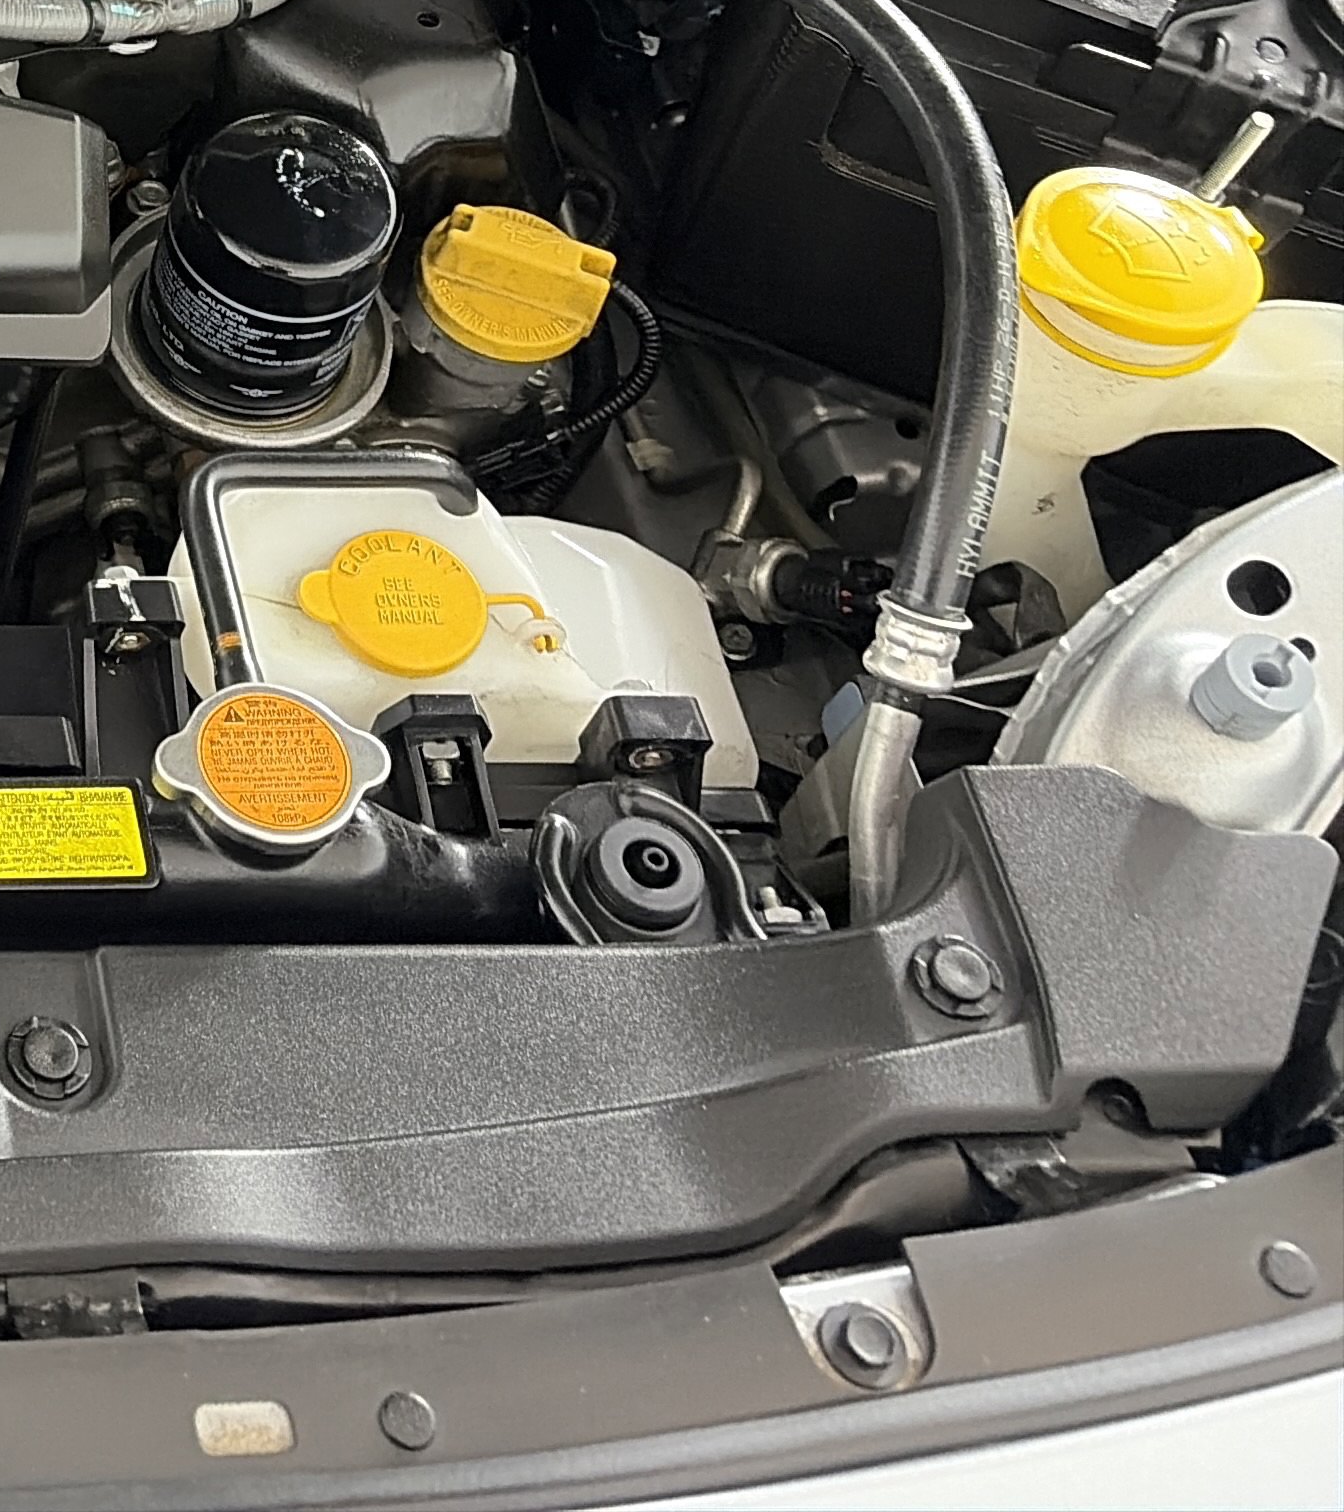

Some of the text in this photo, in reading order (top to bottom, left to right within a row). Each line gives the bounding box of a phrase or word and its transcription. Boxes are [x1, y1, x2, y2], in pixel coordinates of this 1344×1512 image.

[197, 290, 248, 325] CAUTION
[434, 278, 454, 301] SEE
[515, 319, 571, 343] MANUAL
[274, 332, 294, 341] AND
[338, 534, 462, 576] COOLANT
[383, 576, 415, 592] SEE
[375, 592, 441, 609] OWNERS
[378, 609, 444, 625] MANUAL
[244, 708, 302, 718] WARNING
[211, 748, 243, 757] NEVER
[247, 747, 274, 756] OPEN
[276, 747, 307, 756] WHEN
[239, 792, 327, 804] AVERTISSEMENT
[272, 813, 308, 825] 108kPa
